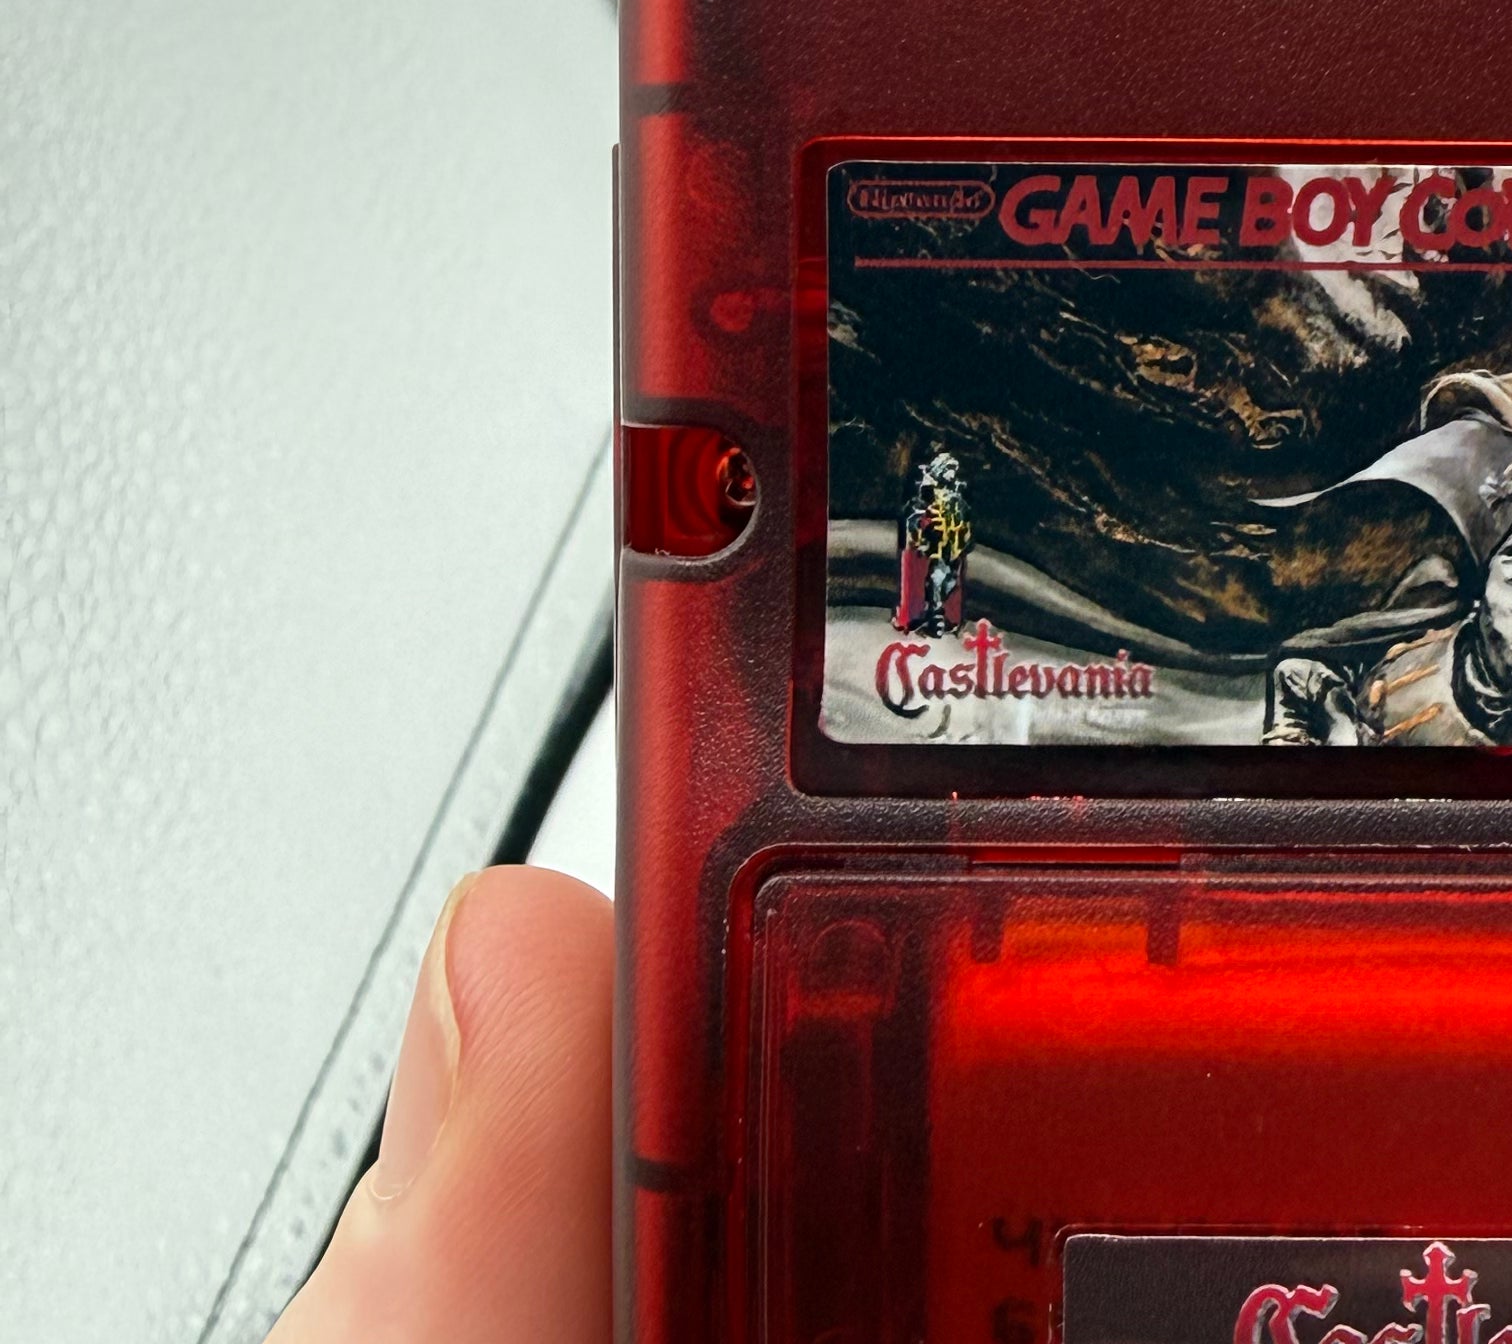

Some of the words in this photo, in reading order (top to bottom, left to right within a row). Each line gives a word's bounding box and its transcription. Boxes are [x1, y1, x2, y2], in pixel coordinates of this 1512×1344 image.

[998, 175, 1228, 246] GAME
[1239, 175, 1397, 246] BOY
[875, 618, 1156, 719] Castlevania
